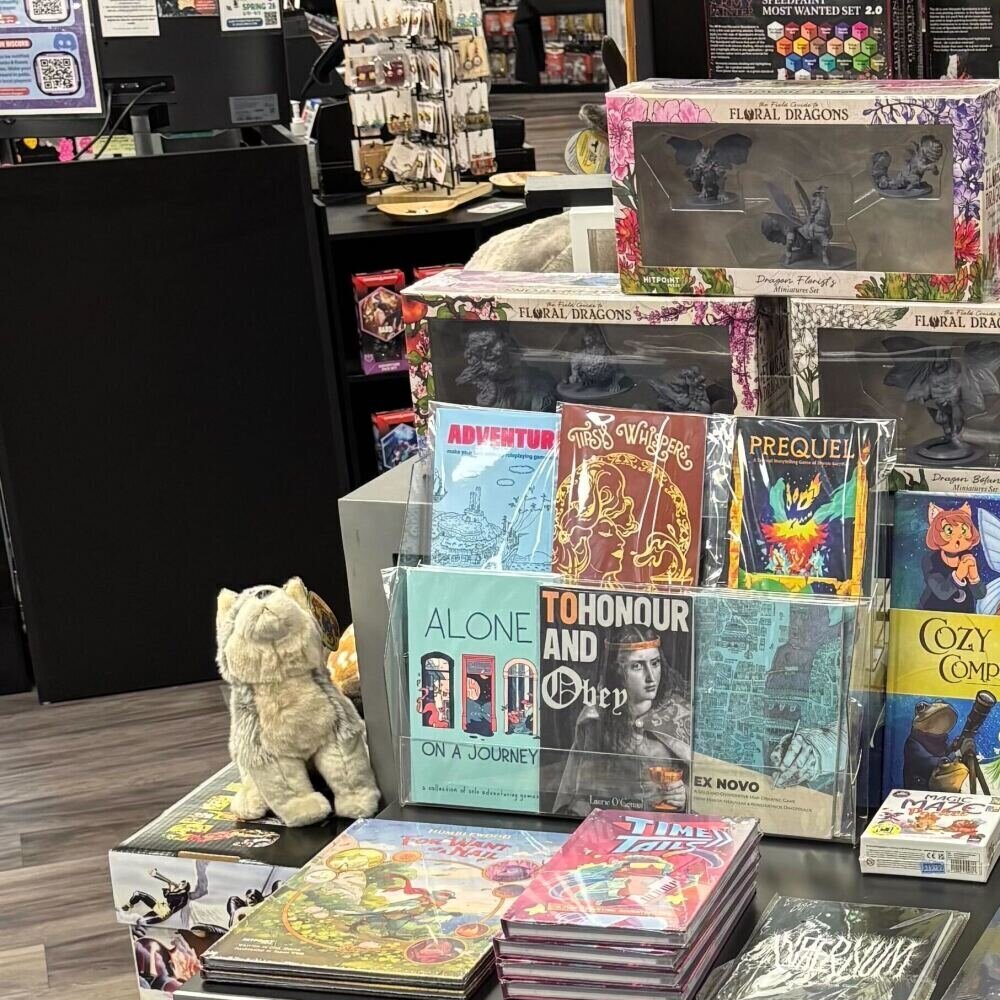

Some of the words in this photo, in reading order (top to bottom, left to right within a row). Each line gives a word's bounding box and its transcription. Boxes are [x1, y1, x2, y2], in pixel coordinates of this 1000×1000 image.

[762, 5, 793, 16] MOST
[795, 6, 840, 16] WANTED
[841, 6, 861, 15] SET
[864, 5, 883, 15] 2.0
[729, 107, 781, 121] FLORAL
[785, 108, 849, 121] DRAGONS
[519, 308, 568, 320] FLORAL
[572, 308, 632, 322] DRAGONS
[914, 315, 967, 329] FLORAL
[447, 424, 556, 450] ADVENTUR
[567, 420, 615, 450] TIPSY
[616, 421, 694, 471] WHISPERS
[748, 435, 855, 459] PREQUEL
[579, 593, 690, 633] HONOUR
[424, 607, 533, 644] ALONE
[918, 617, 993, 656] COZY
[543, 628, 598, 663] AND
[541, 665, 628, 716] Obey
[421, 741, 445, 758] ON
[451, 744, 462, 760] A
[468, 745, 539, 765] JOURNEY
[693, 776, 713, 788] EX
[716, 778, 760, 793] NOVO
[901, 798, 987, 815] MAZE
[924, 793, 974, 804] MAGIC
[623, 815, 711, 838] TIME
[610, 835, 703, 854] TAILS
